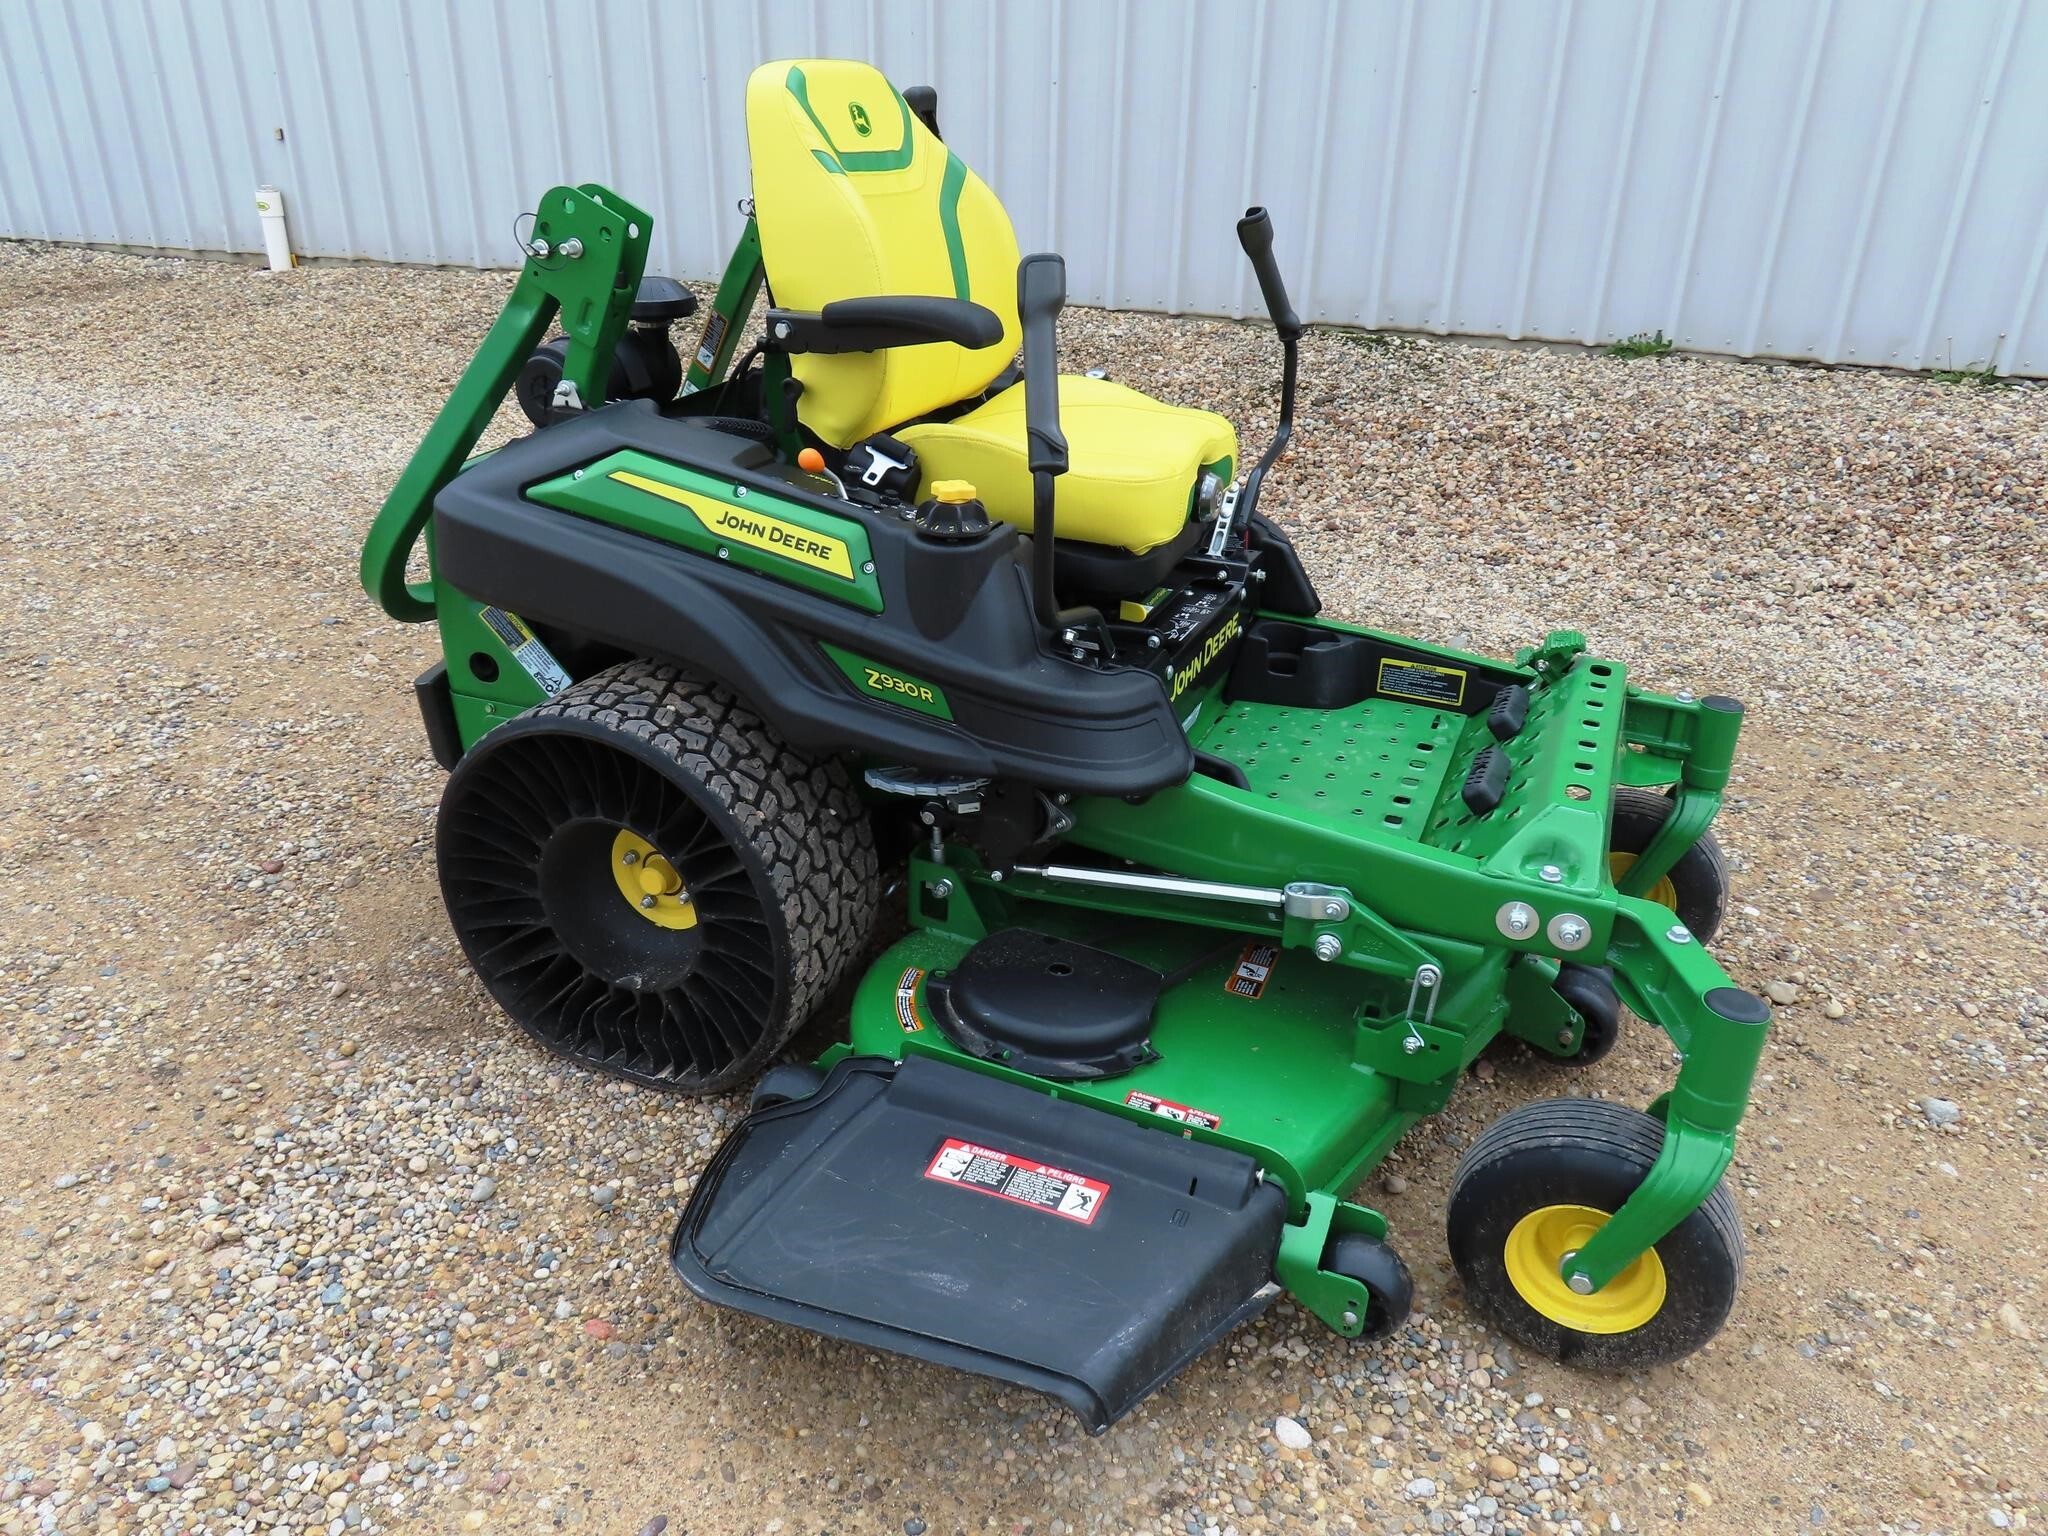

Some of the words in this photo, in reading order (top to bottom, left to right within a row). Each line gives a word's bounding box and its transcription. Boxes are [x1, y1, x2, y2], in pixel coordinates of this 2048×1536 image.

[716, 511, 766, 538] JOHN
[768, 526, 832, 560] DEERE
[1170, 651, 1203, 702] JOHN
[1203, 612, 1239, 667] DEERE
[864, 667, 935, 704] Z930R
[971, 1146, 1007, 1162] DANGER
[1046, 1168, 1086, 1186] PELIGRO
